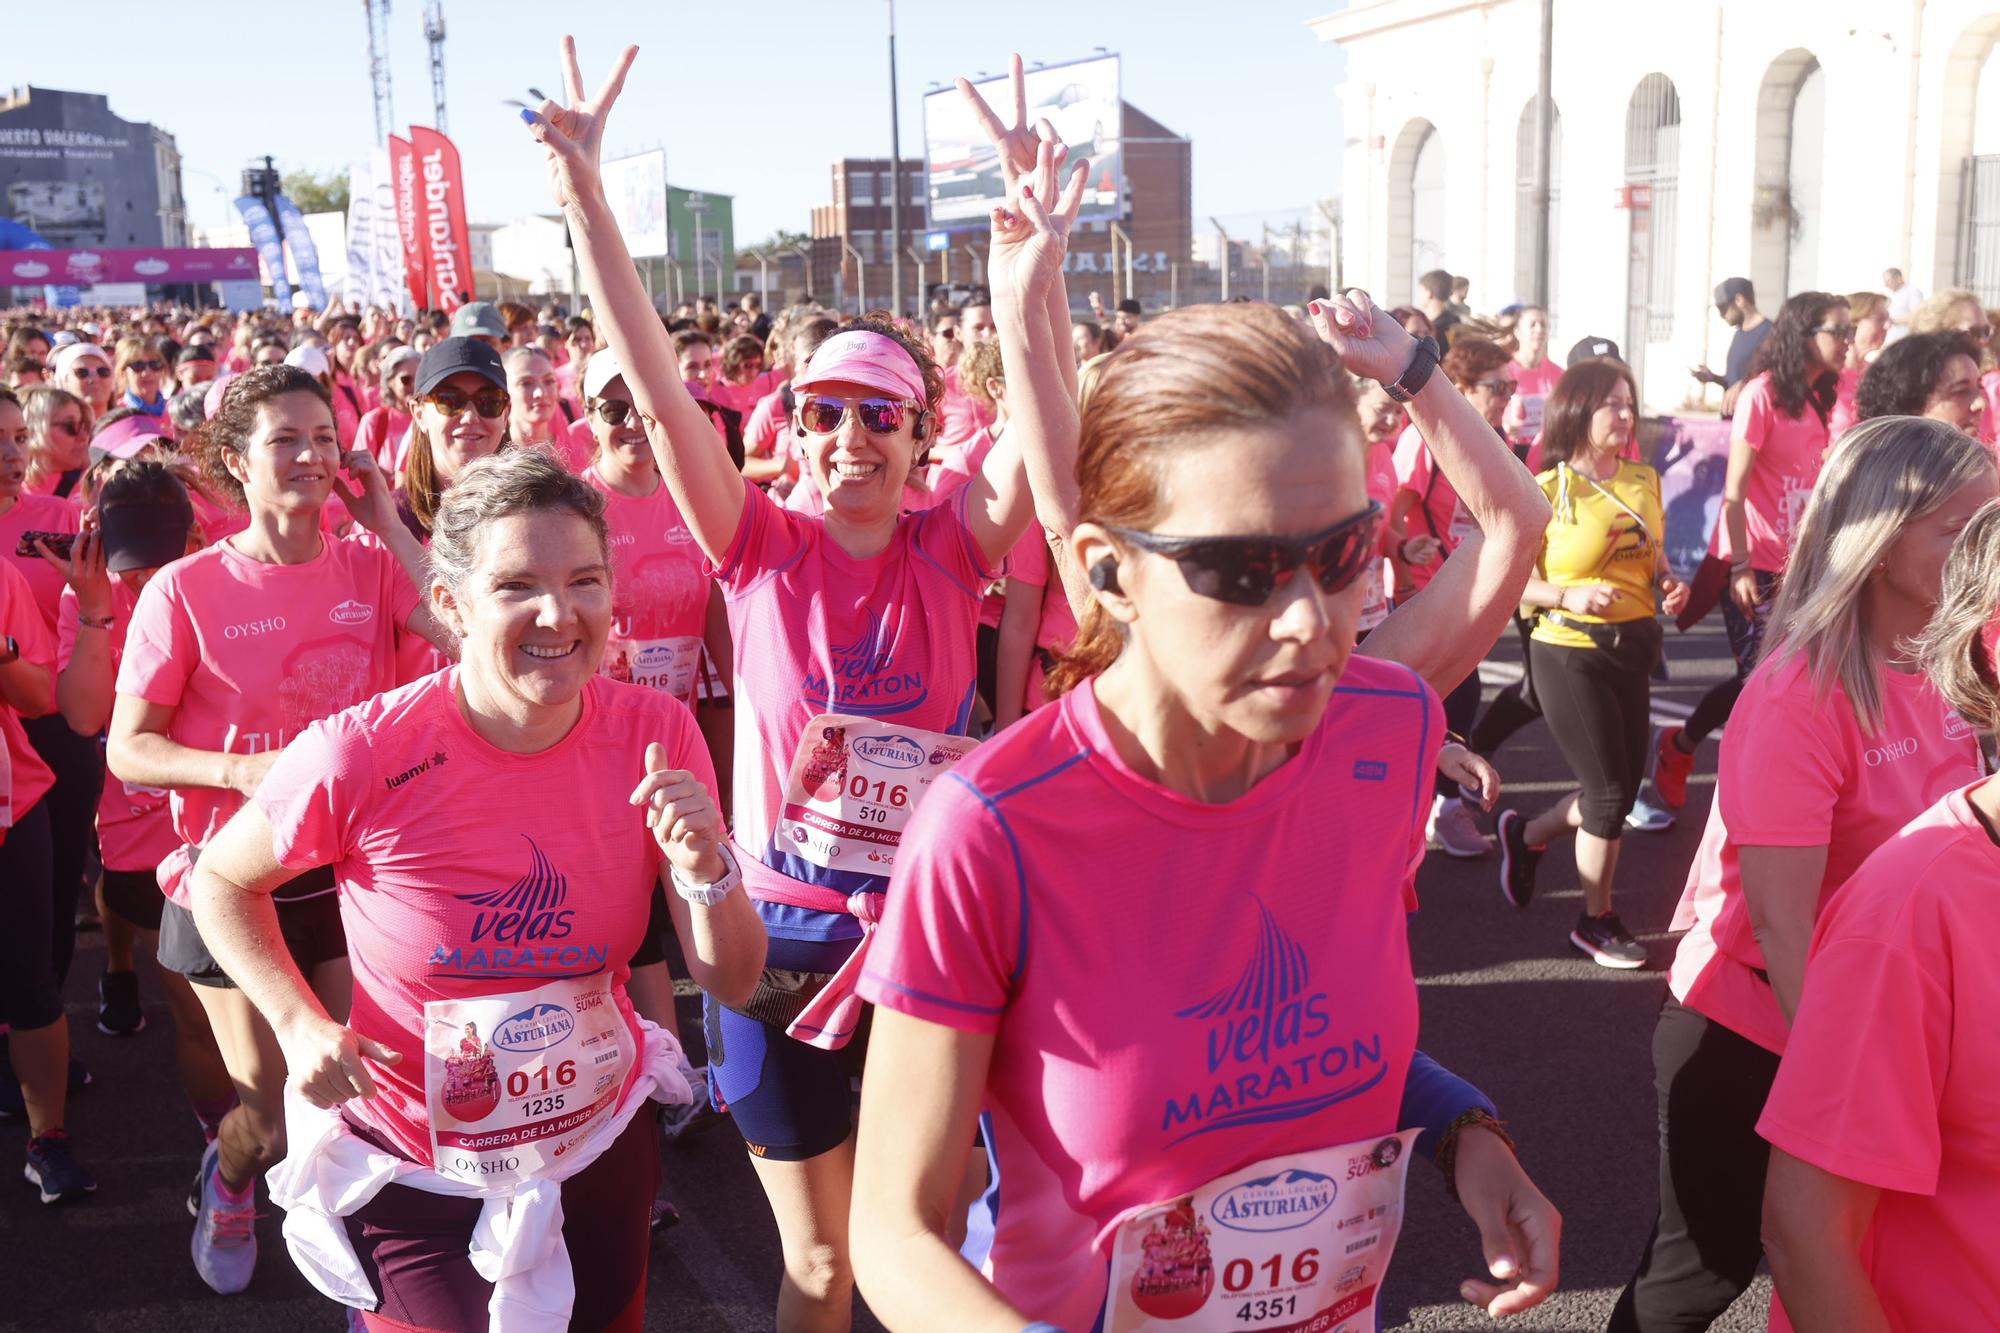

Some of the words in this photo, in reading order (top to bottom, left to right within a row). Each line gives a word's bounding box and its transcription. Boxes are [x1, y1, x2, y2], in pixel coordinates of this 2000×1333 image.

[224, 616, 286, 640] OYSHO
[801, 671, 921, 701] MARATON
[857, 740, 919, 765] ASTURIANA
[1863, 737, 1919, 767] OYSHO
[385, 757, 430, 789] luanvi
[849, 775, 909, 807] 016
[802, 812, 847, 836] CARRERA
[848, 828, 863, 839] DE
[864, 830, 876, 842] LA
[859, 806, 887, 824] 510
[470, 909, 576, 947] velas
[428, 943, 609, 970] MARATON
[576, 996, 604, 1013] SUMA
[500, 1018, 572, 1046] ASTURIANA
[1207, 992, 1330, 1074] velas
[506, 1059, 577, 1097] 016
[1161, 1033, 1381, 1131] MARATON
[521, 1094, 565, 1118] 1235
[459, 1132, 518, 1149] CARRERA
[521, 1128, 538, 1140] DE
[540, 1123, 556, 1135] LA
[557, 1110, 592, 1131] MUJER
[456, 1156, 520, 1175] OYSHO
[1221, 1191, 1329, 1220] ASTURIANA
[1222, 1247, 1320, 1293] 016
[1236, 1294, 1297, 1323] 4351
